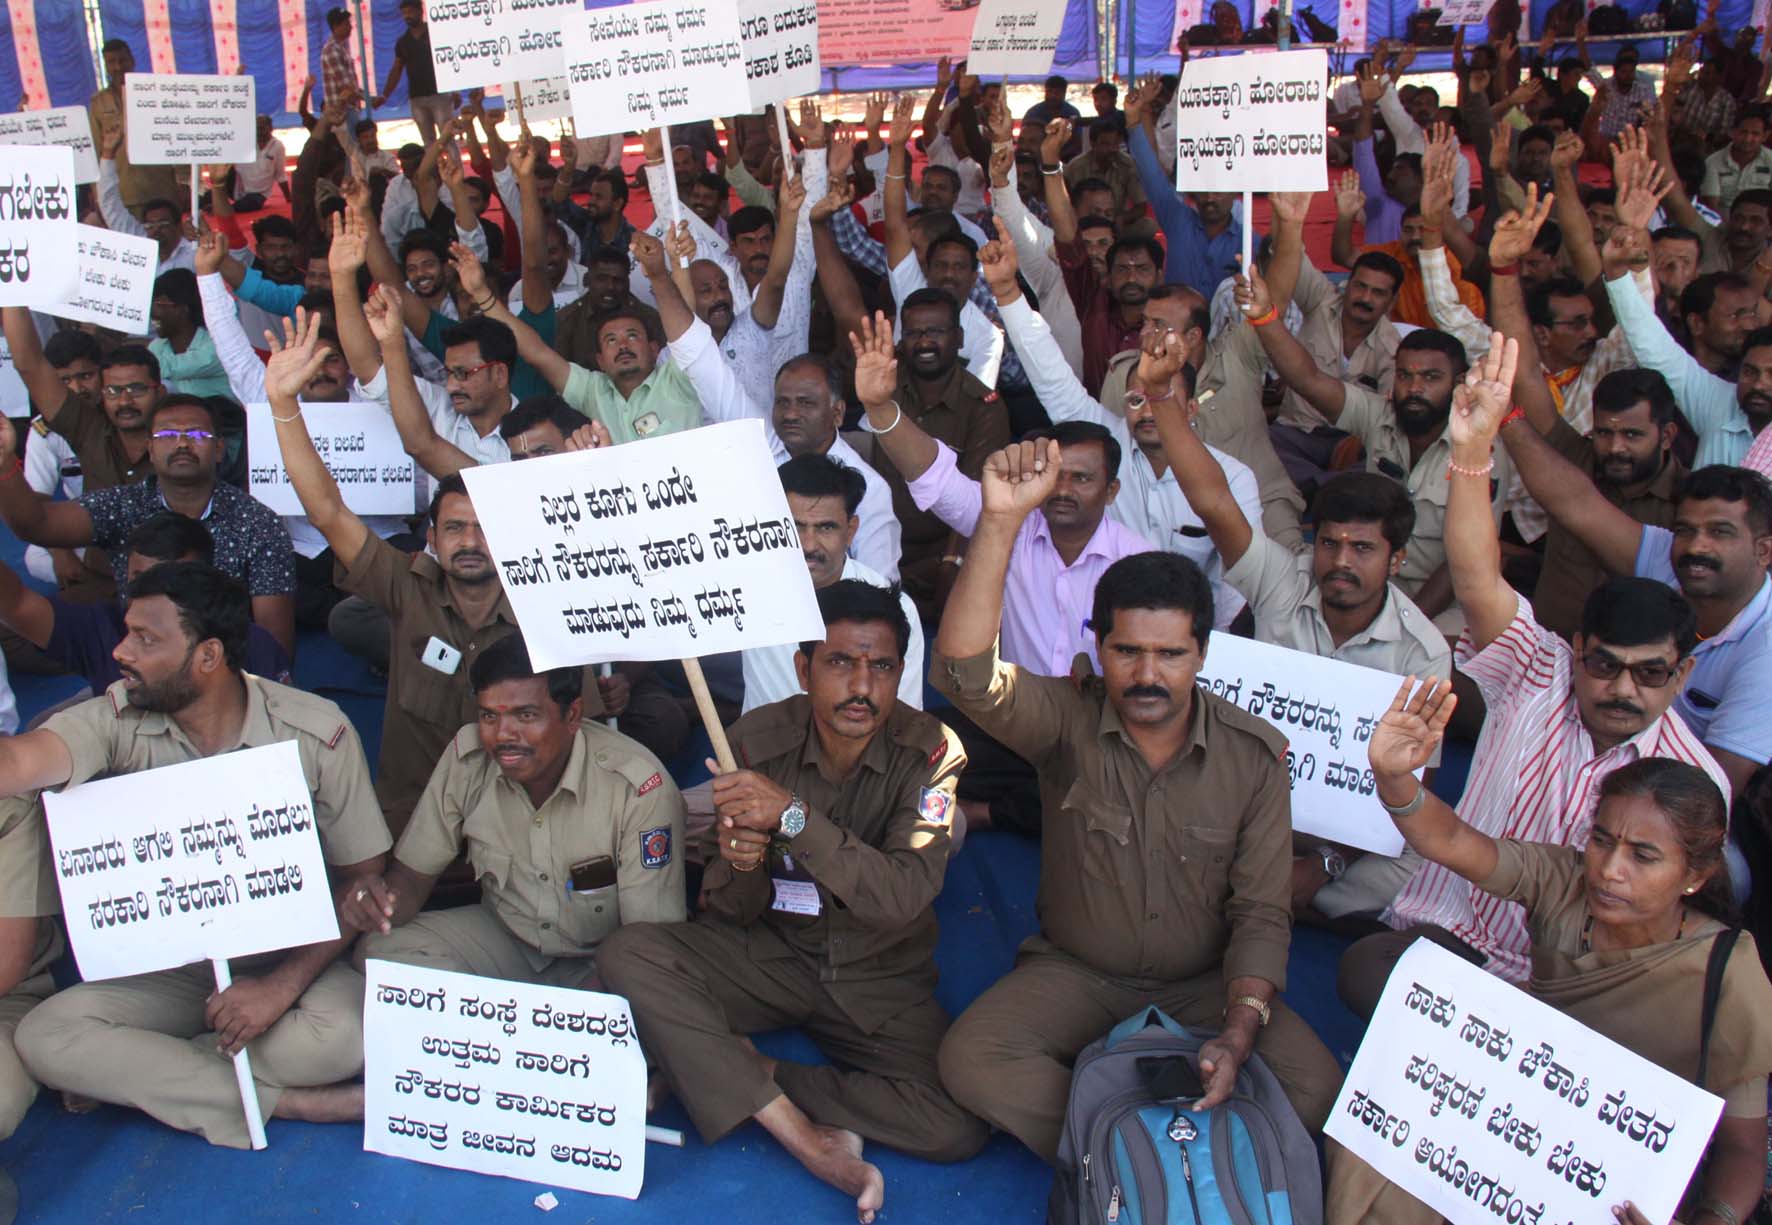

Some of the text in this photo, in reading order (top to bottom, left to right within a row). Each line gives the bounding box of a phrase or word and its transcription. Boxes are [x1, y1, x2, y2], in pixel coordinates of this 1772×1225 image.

[589, 8, 706, 42] ಸೇವೆಯೇ ನಮ್ಮ ಧರ್ಮ
[435, 36, 511, 73] ನ್ಯಾಯಕ್ಕಾಗಿ
[569, 59, 611, 83] ಸರ್ಕಾರಿ
[617, 49, 676, 76] ನೌಕರನಾಗಿ
[681, 40, 740, 68] ಮಾಡುವುದು
[628, 87, 688, 120] ನಿಮ್ಮ ಧರ್ಮ
[1180, 76, 1319, 120] ಯಾತಕ್ಕಾಗಿ ಹೋರಾಟ
[1179, 128, 1323, 171] ನ್ಯಾಯಕ್ಕಾಗಿ ಹೋರಾಟ
[0, 173, 69, 220] ಗಬೇಕು
[0, 242, 30, 283] ಕರ
[540, 466, 697, 536] ಎಲ್ಲರ ಕೂಗು ಒಂದೇ
[501, 517, 799, 588] ಸಾರಿಗೆ ನೌಕರರನ್ನು ಸರ್ಕಾರಿ ನೌಕರನಾಗಿ
[562, 597, 646, 639] ಮಾಡುವುದು
[650, 592, 697, 639] ನಿಮ್ಮ
[59, 803, 311, 878] ಏನಾದರು ಆಗಲಿ ನಮ್ಮನ್ನು ಮೊದಲು
[88, 862, 303, 929] ಸರಕಾರಿ ನೌಕರನಾಗಿ ಮಾಡಲಿ
[377, 984, 446, 1012] ಸಾರಿಗೆ
[460, 996, 517, 1037] ಸಂಸ್ಥೆ
[422, 1036, 590, 1078] ಉತ್ತಮ ಸಾರಿಗೆ
[1405, 982, 1675, 1153] ಸಾಕು ಸಾಕು ಚೌಕಾಸಿ ವೇತನ
[395, 1069, 616, 1126] ನೌಕರರ ಕಾರ್ಮಿಕರ
[1347, 1090, 1410, 1147] ಸರ್ಕಾರಿ
[388, 1115, 448, 1151] ಮಾತ್ರ
[462, 1130, 536, 1157] ಜೀವನ
[1405, 1055, 1606, 1198] ಪರಿಷ್ಕರಣೆ ಬೇಕು ಬೇಕು
